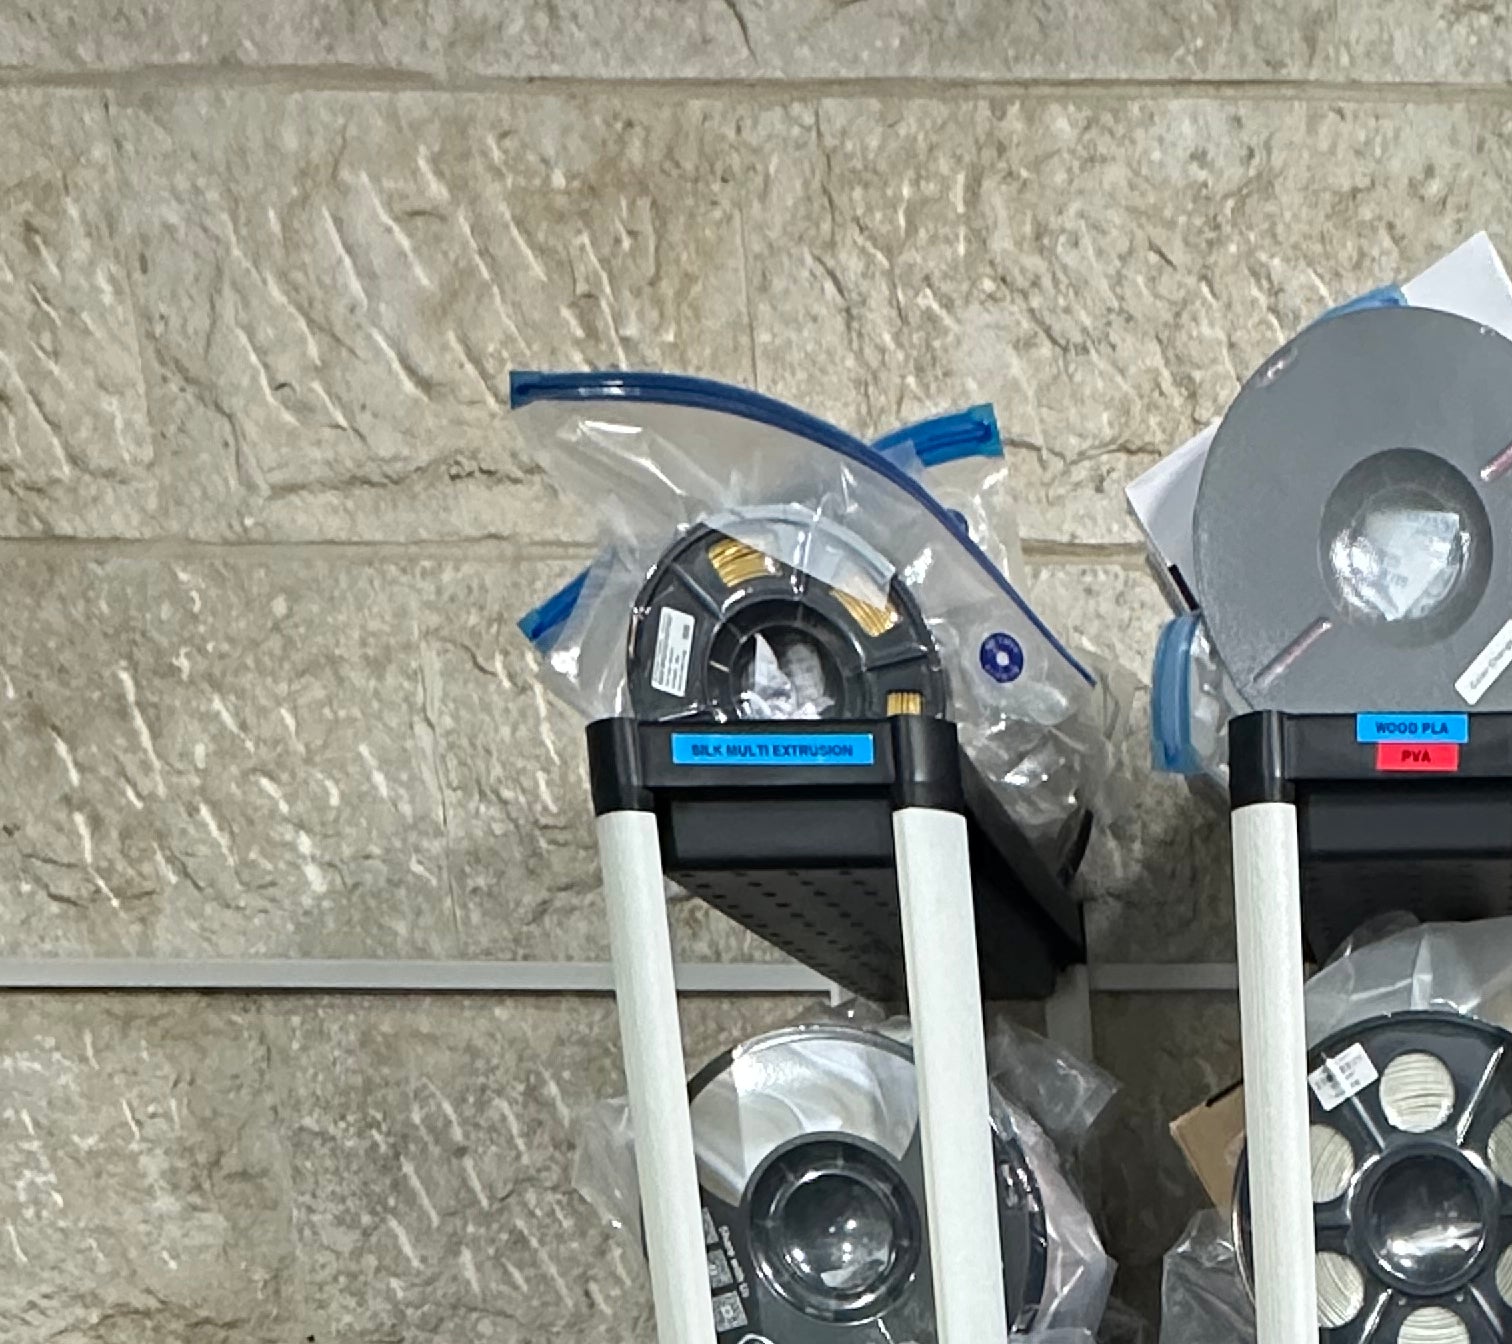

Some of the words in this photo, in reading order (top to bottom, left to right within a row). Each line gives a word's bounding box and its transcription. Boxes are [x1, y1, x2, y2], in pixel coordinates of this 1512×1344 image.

[1375, 720, 1418, 734] WOOD
[1422, 721, 1448, 734] PLA
[691, 744, 722, 757] SILK
[726, 744, 769, 757] MULTI
[772, 744, 854, 757] EXTRUSION
[1401, 750, 1431, 762] PVA
